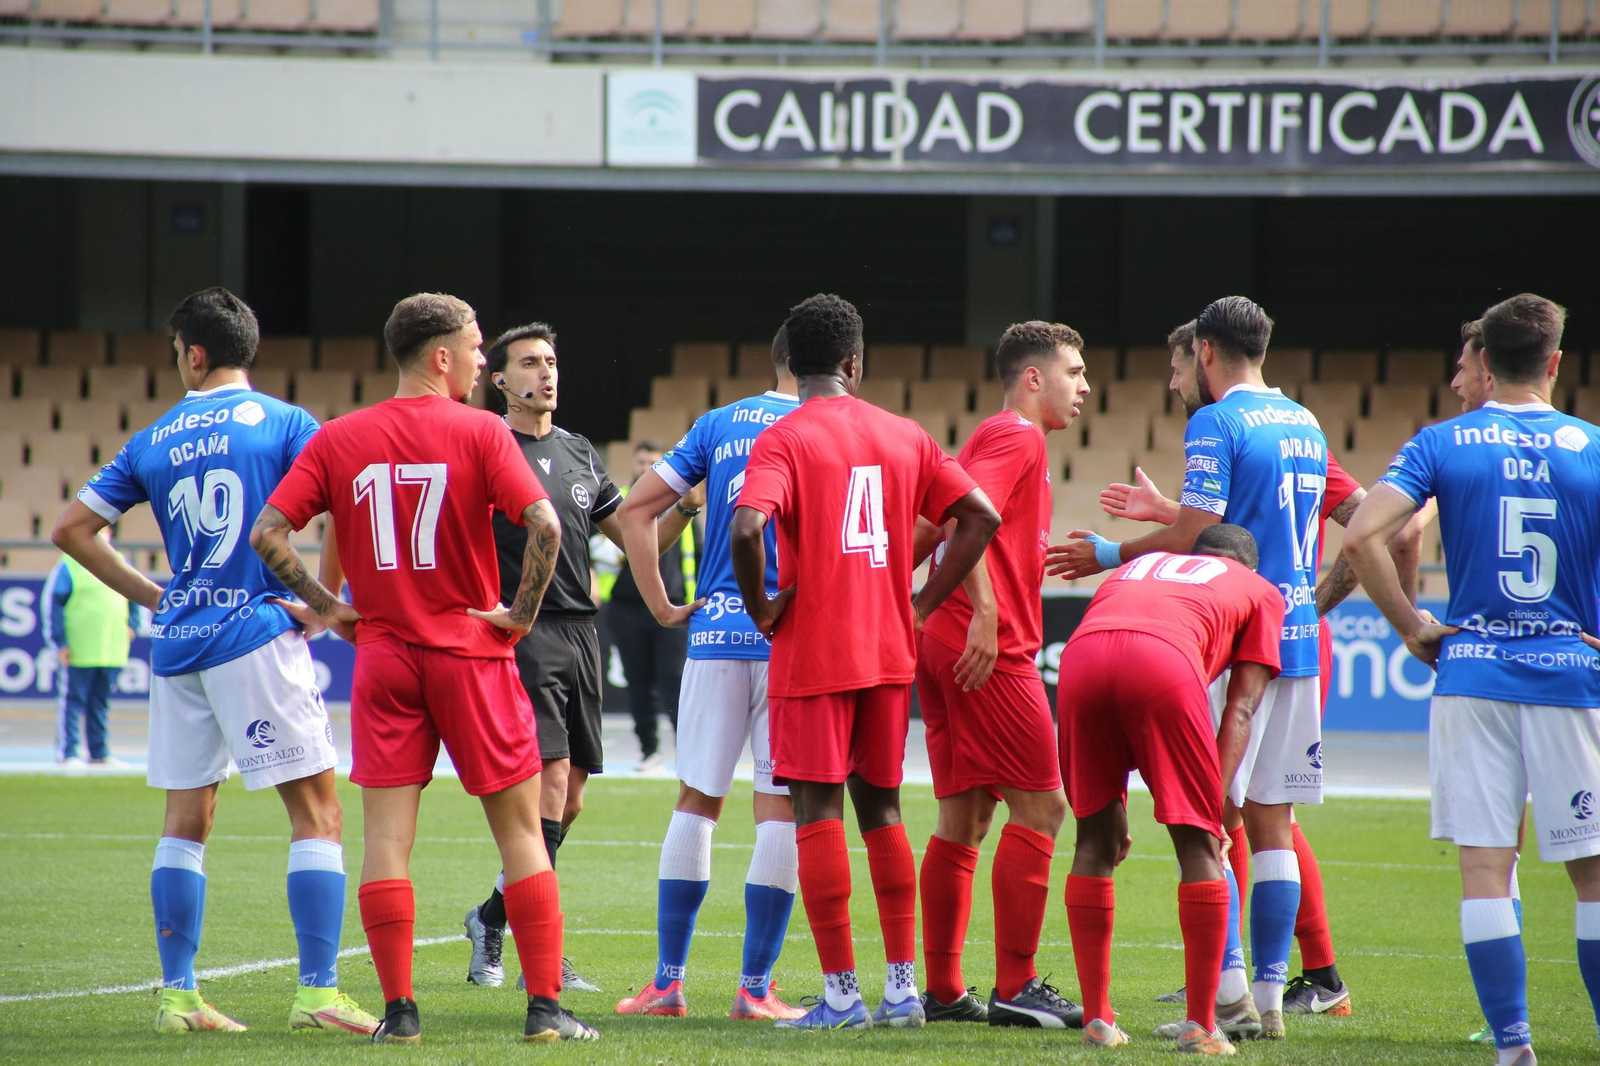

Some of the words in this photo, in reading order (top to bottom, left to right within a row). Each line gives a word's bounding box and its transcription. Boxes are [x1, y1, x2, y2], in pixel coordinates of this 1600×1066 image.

[714, 88, 1023, 153] CALIDAD
[1073, 91, 1545, 155] CERTIFICADA
[150, 407, 230, 446] indeso
[1238, 404, 1309, 428] indeso
[168, 431, 229, 467] OCAÑA
[1279, 436, 1322, 463] DURÁN
[1453, 423, 1552, 449] indeso
[1503, 457, 1551, 484] OCA
[167, 468, 244, 573] 19
[352, 463, 447, 571] 17
[841, 464, 889, 569] 4
[1278, 472, 1327, 573] 17
[1497, 495, 1558, 604] 5
[1120, 551, 1228, 585] 10
[691, 630, 726, 647] XEREZ
[1447, 643, 1498, 661] XEREZ
